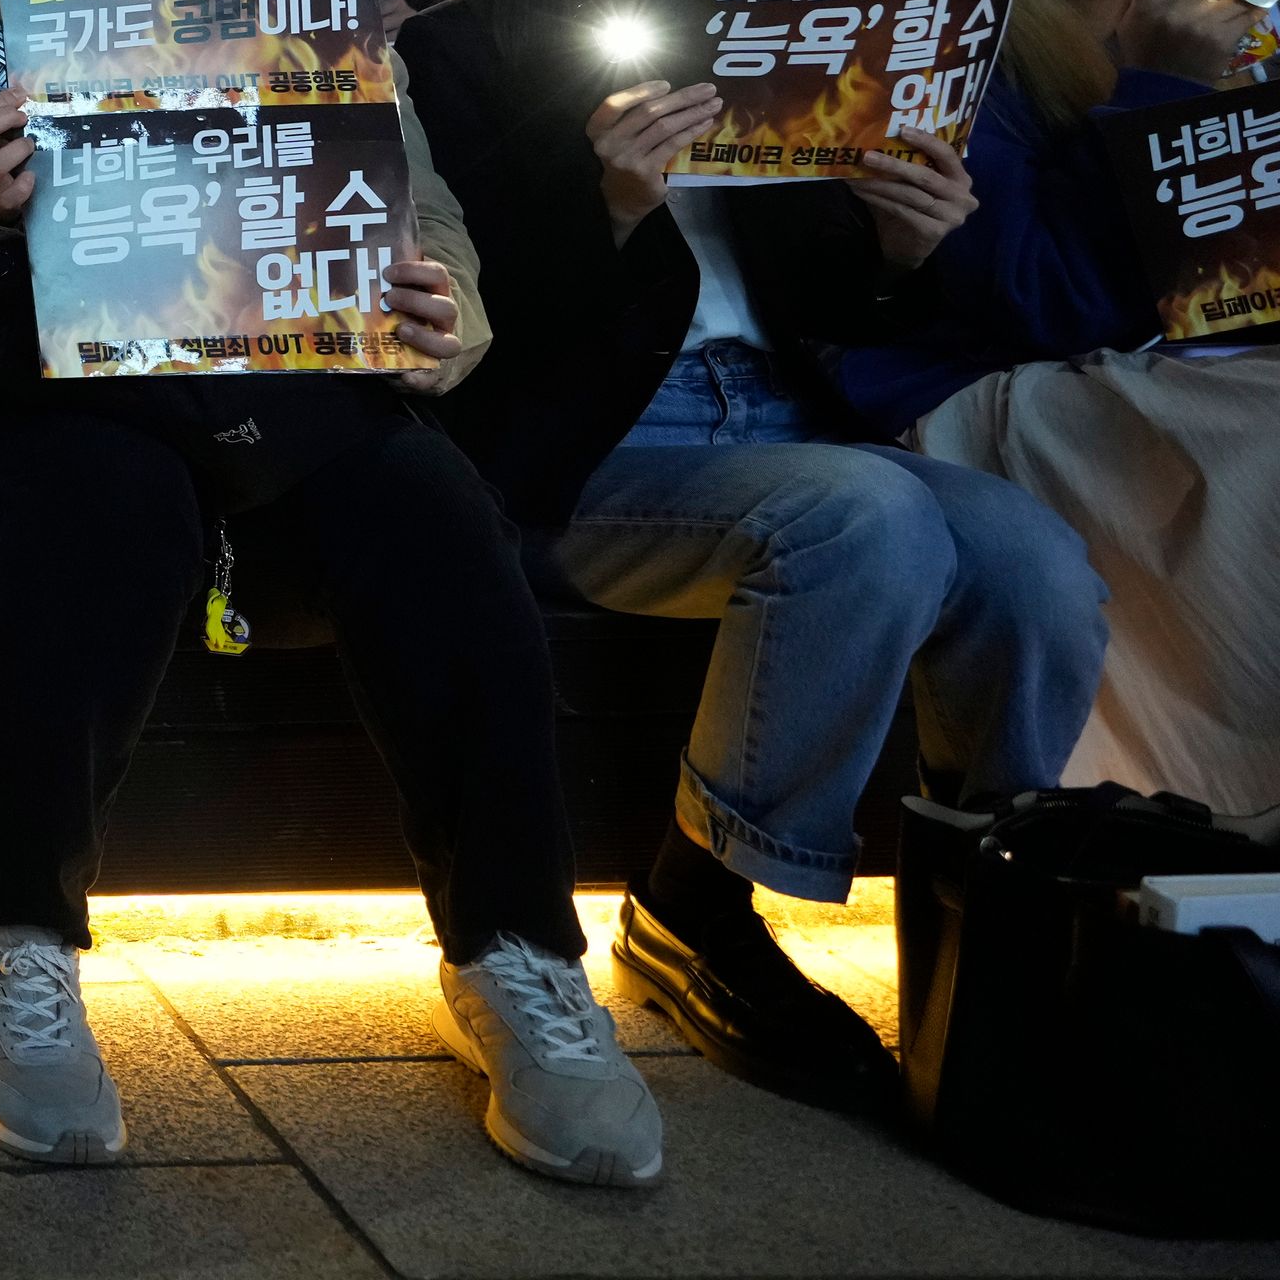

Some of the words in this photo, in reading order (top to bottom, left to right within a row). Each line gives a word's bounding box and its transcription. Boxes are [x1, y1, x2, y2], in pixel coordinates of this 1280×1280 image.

[26, 2, 154, 57] 국가도
[45, 76, 135, 103] 딥페이크
[140, 73, 209, 98] 성범죄
[215, 71, 260, 94] OUT
[269, 70, 357, 94] 공동행동
[884, 59, 986, 138] 없다!
[51, 135, 177, 187] 너희는
[191, 122, 315, 174] 우리를
[689, 142, 784, 166] 딥페이크
[791, 142, 864, 166] 성범죄
[1148, 107, 1280, 172] 너희는
[325, 170, 387, 242] 수
[255, 246, 393, 321] 없다!
[179, 334, 250, 359] 성범죄
[257, 333, 303, 356] OUT
[313, 331, 404, 355] 공동행동
